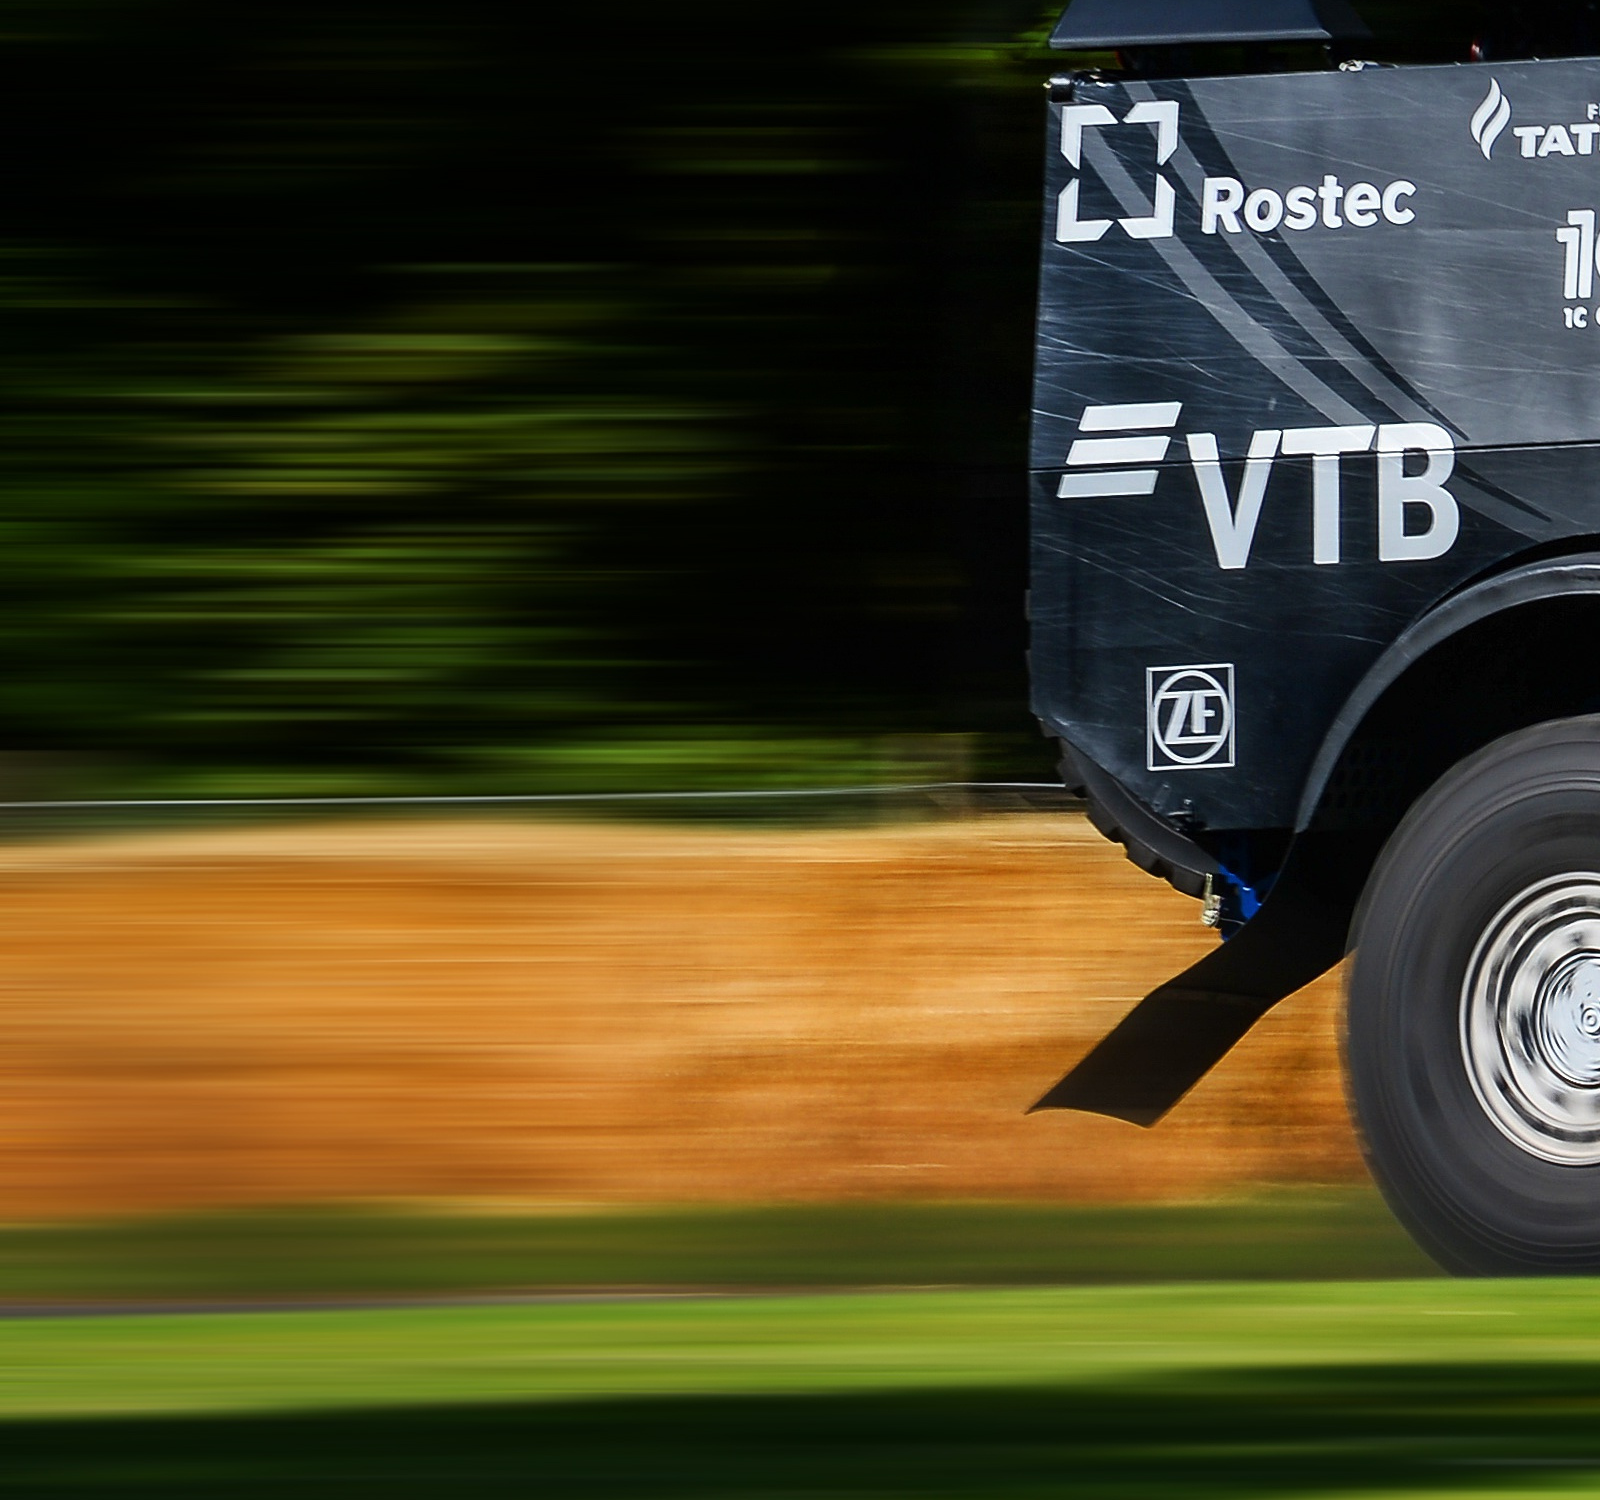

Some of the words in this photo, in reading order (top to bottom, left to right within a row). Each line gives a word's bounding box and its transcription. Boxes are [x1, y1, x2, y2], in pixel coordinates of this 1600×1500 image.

[1201, 174, 1416, 234] Rostec
[1563, 307, 1587, 328] 1C
[1186, 422, 1460, 569] VTB
